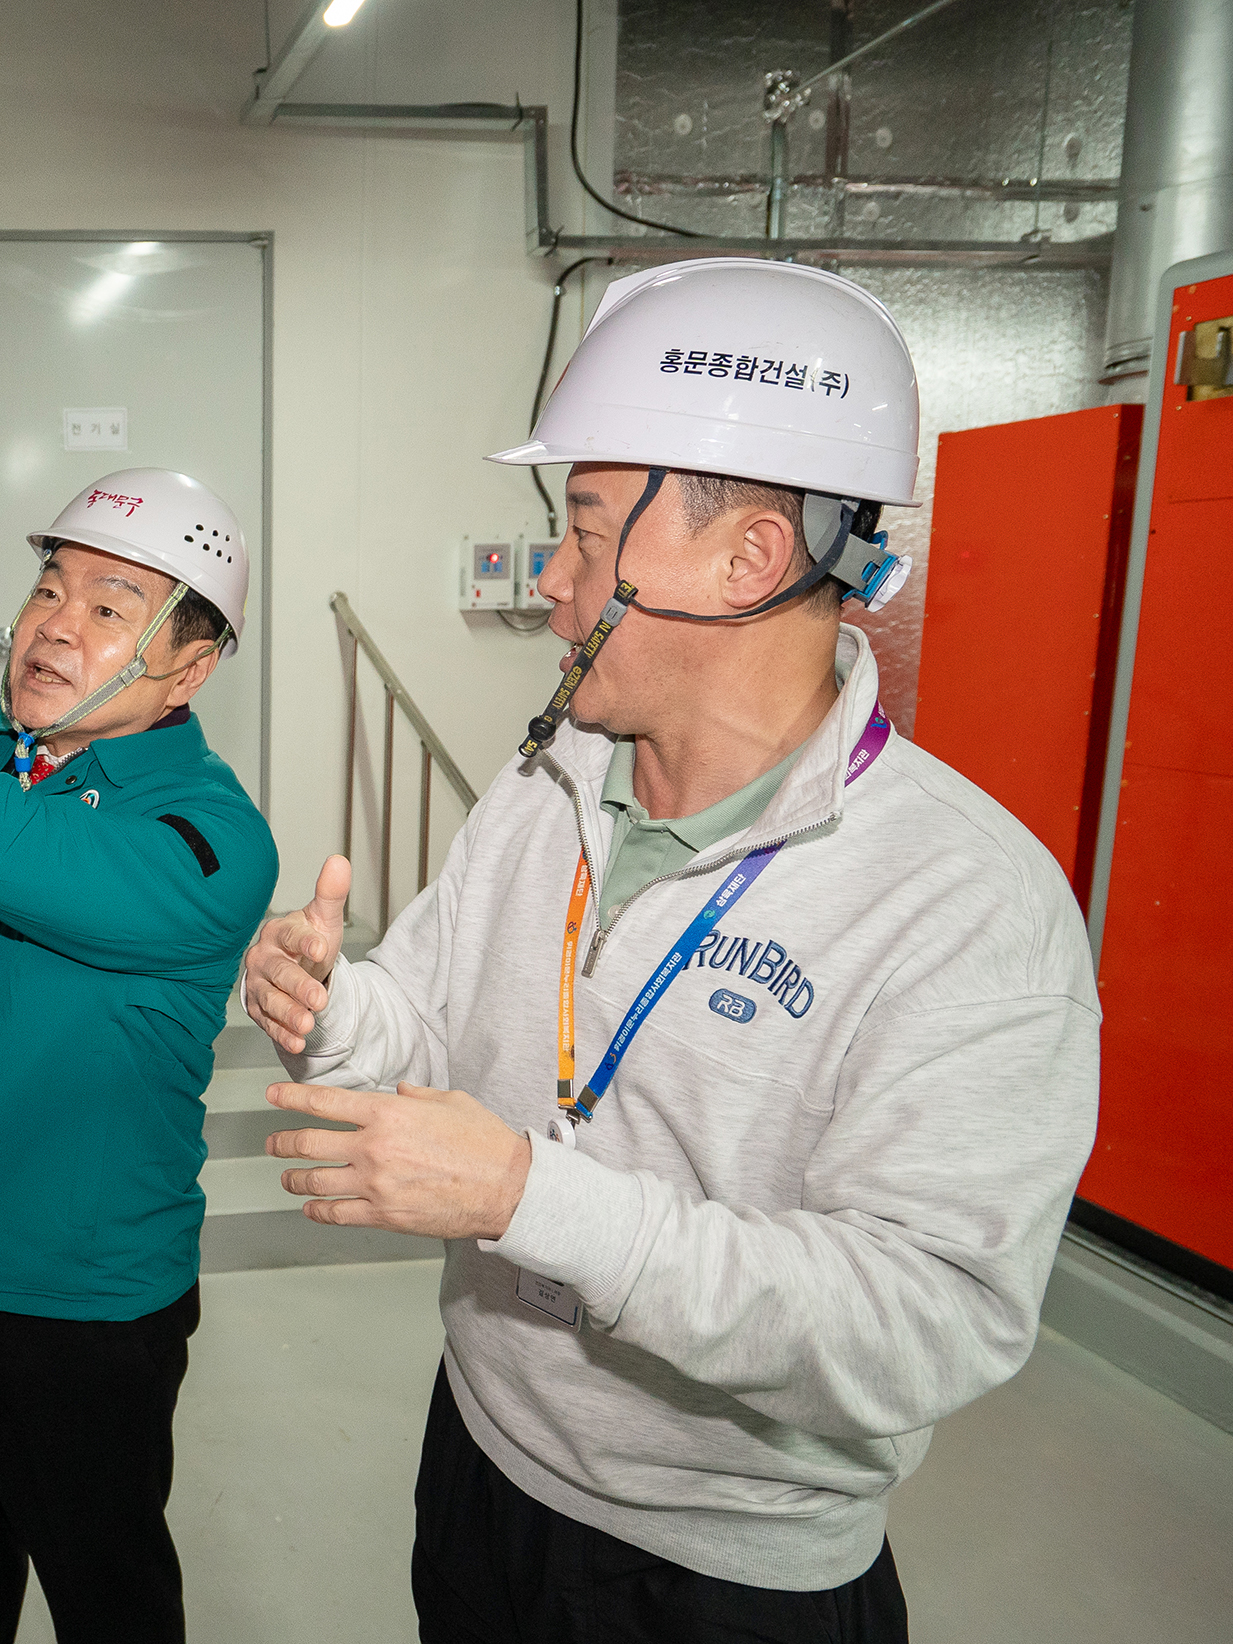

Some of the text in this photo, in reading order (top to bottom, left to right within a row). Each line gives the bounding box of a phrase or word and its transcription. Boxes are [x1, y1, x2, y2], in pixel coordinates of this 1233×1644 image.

[659, 348, 850, 399] 홍문종합건설(주)
[87, 489, 144, 518] 동대문구
[583, 630, 604, 659] SAFETY
[552, 687, 571, 710] SAFETY
[716, 873, 746, 908] 삼육재단
[716, 993, 746, 1017] RB
